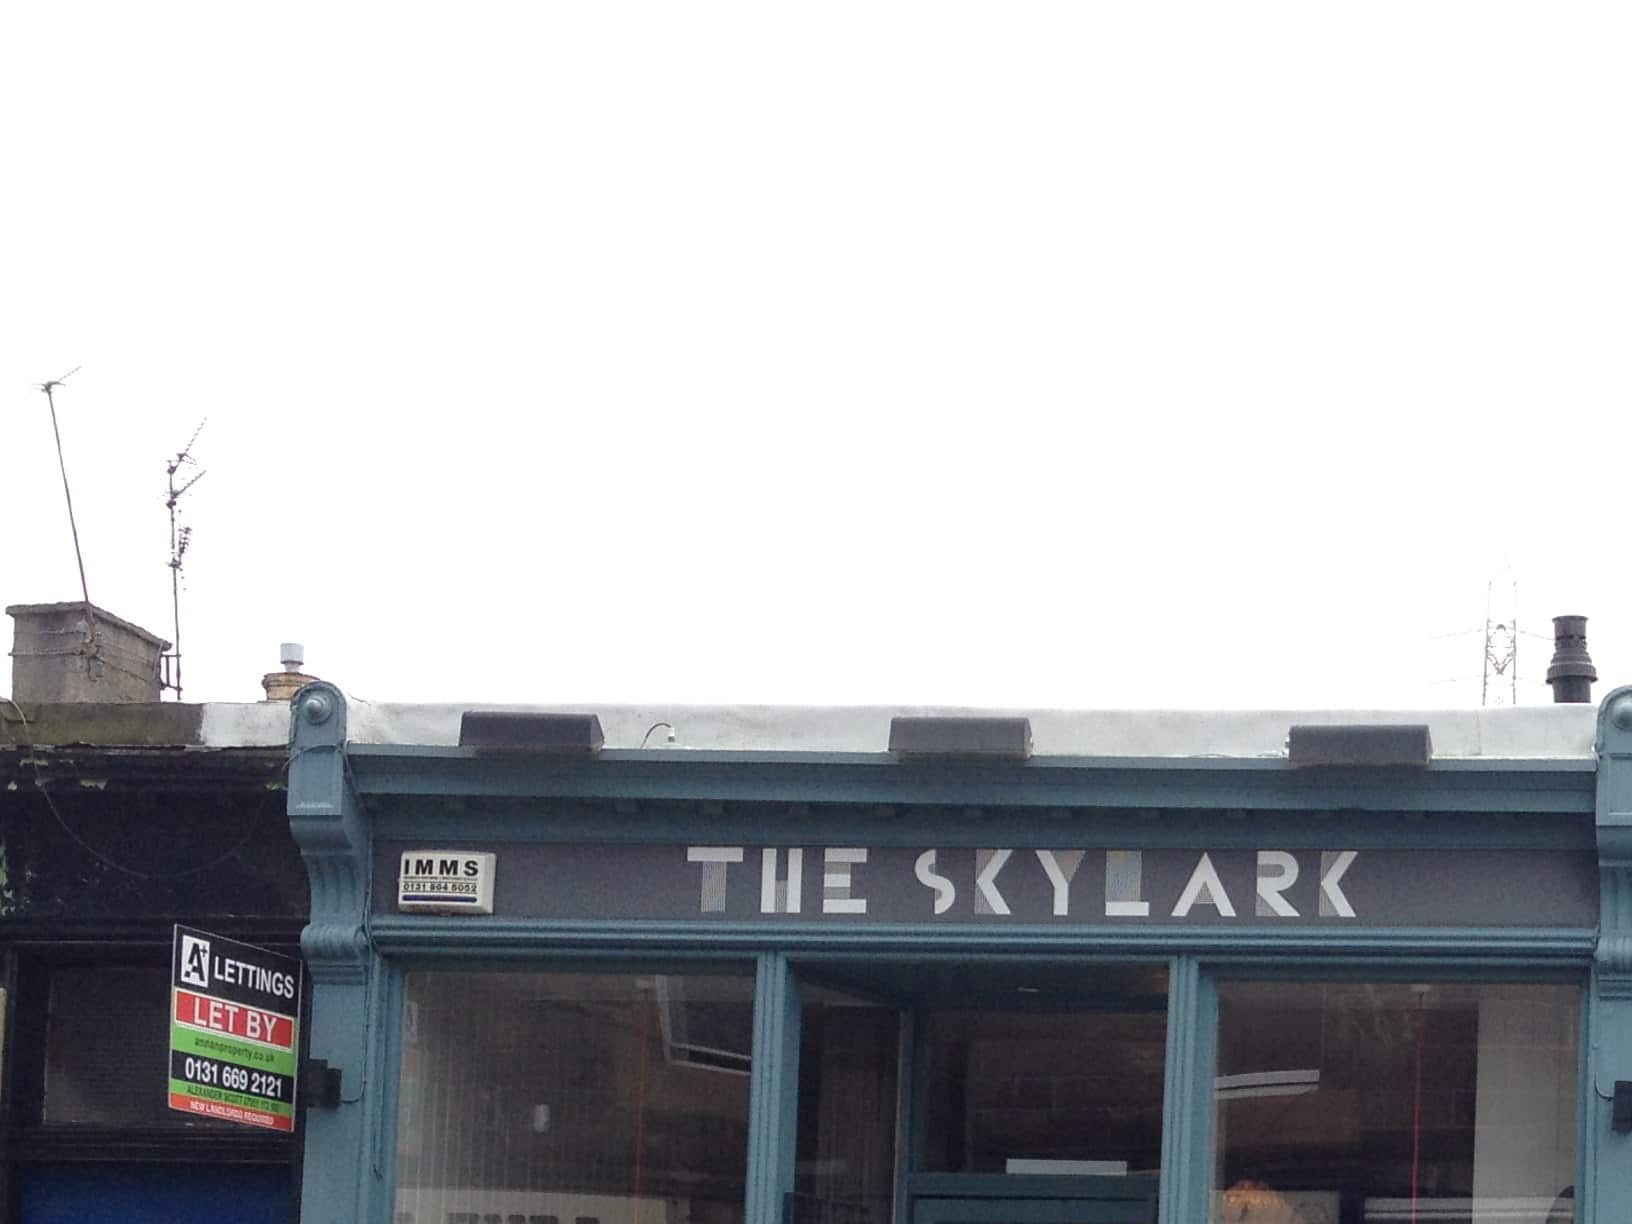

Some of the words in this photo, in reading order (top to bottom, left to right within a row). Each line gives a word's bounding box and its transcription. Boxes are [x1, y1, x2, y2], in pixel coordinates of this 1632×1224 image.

[404, 859, 479, 877] IMMS
[687, 847, 867, 914] THE
[914, 849, 1358, 917] SKYLARK
[214, 956, 294, 998] LETTINGS
[194, 997, 239, 1033] LET
[247, 1010, 277, 1041] BY
[185, 1057, 217, 1084] 0131
[222, 1067, 248, 1090] 669
[251, 1072, 282, 1098] 2121
